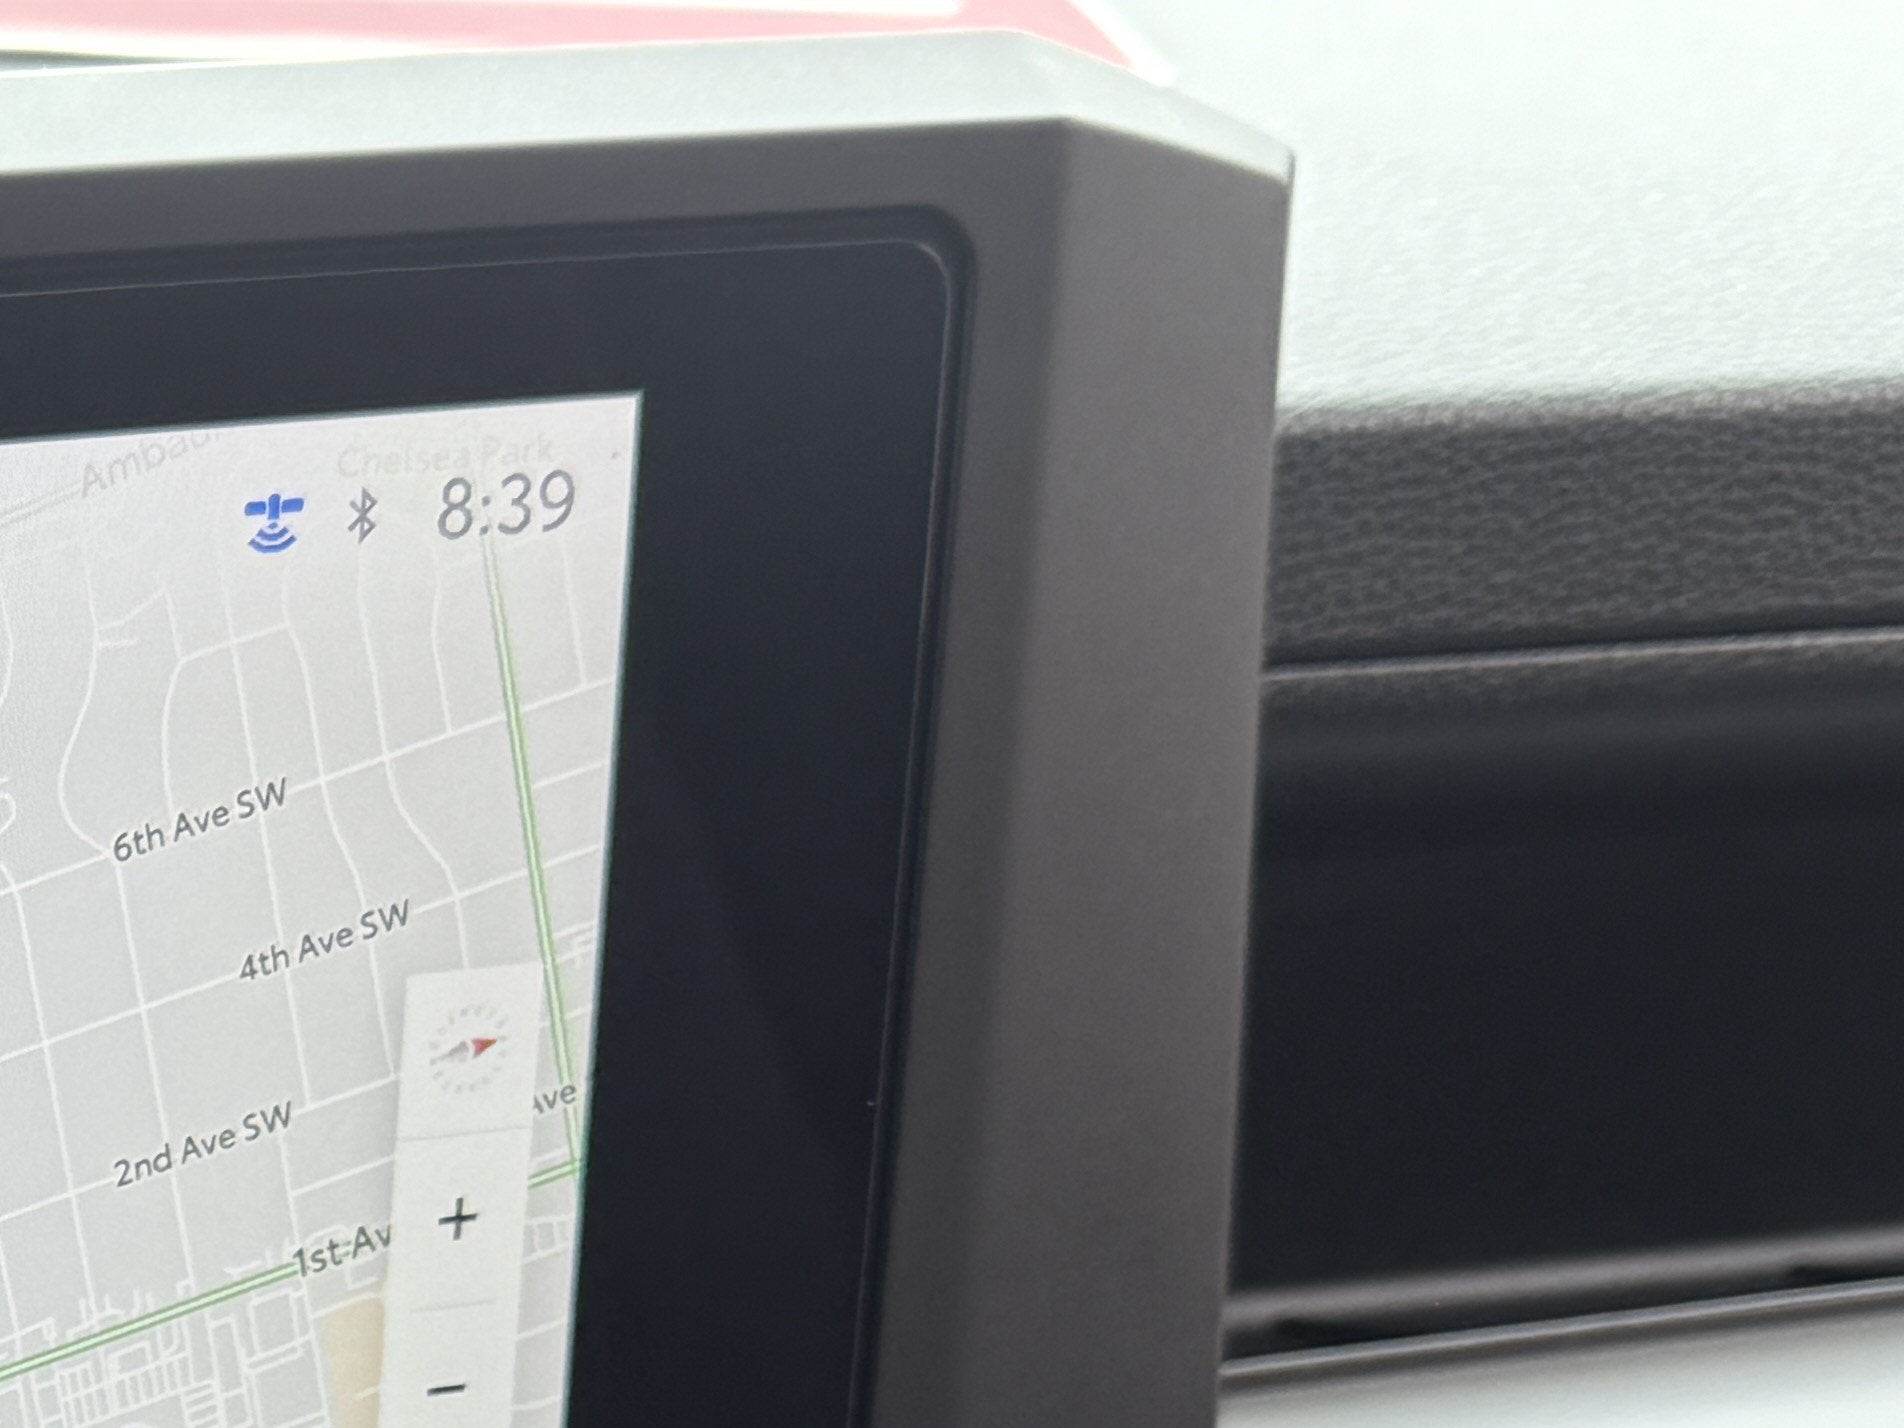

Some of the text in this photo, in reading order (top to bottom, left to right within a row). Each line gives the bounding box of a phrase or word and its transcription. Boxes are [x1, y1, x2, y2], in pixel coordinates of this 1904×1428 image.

[438, 469, 575, 540] 8:39
[113, 776, 288, 862] 6th Ave SW
[239, 898, 410, 981] 4th Ave SW
[114, 1100, 292, 1187] 2nd Ave SW
[293, 1237, 341, 1277] 1st
